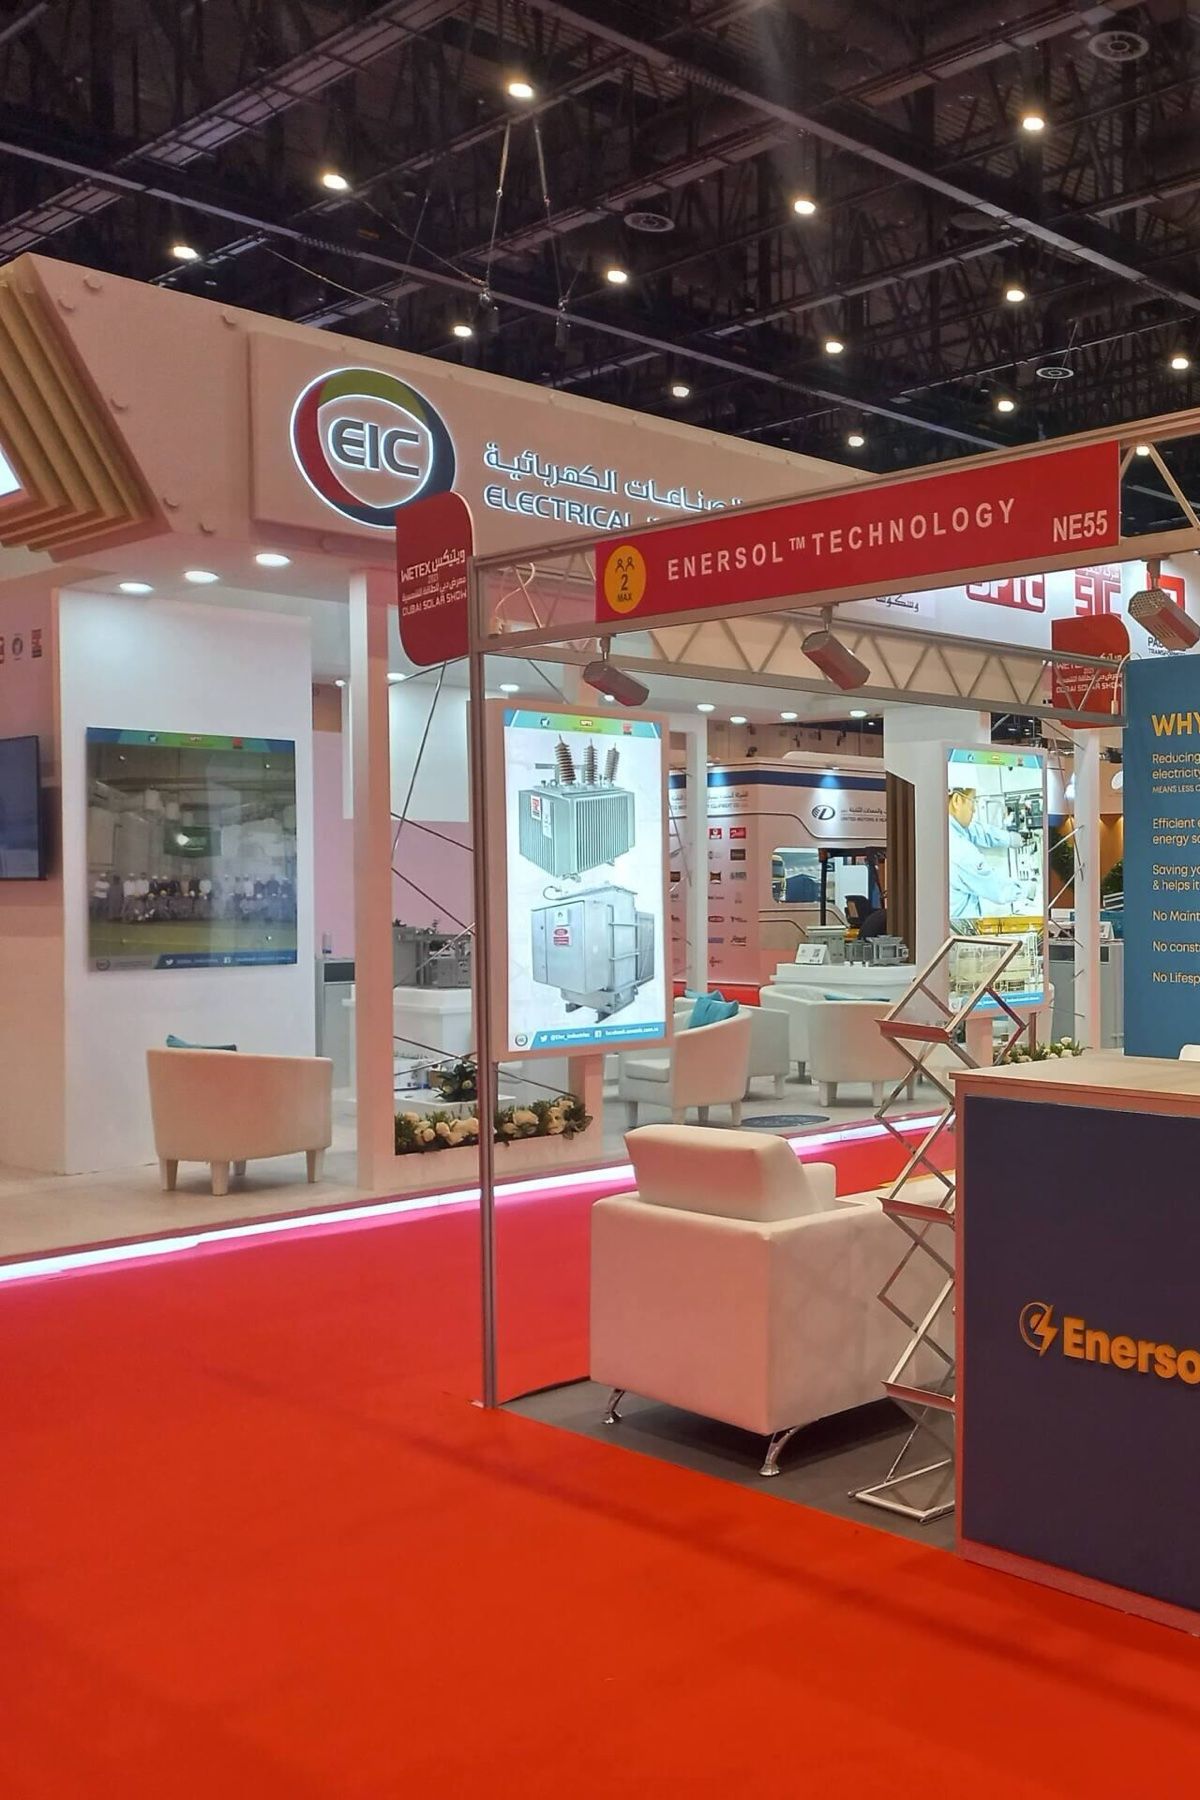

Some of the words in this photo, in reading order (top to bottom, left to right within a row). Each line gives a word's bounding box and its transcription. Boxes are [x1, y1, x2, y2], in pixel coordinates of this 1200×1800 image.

[327, 417, 420, 477] EIC
[483, 440, 616, 494] الكهربائية
[483, 485, 631, 531] ELECTRICAL
[812, 498, 1015, 556] TECHNOLOGY
[1053, 510, 1108, 542] NE55
[401, 561, 431, 583] WETEX
[621, 574, 628, 591] 2
[402, 603, 422, 616] DUBAI
[423, 594, 445, 610] SOLAR
[446, 589, 467, 603] SHOW
[617, 593, 632, 601] MAX
[1152, 752, 1200, 765] Reducing
[1152, 785, 1178, 794] MEANS
[1178, 784, 1195, 793] LESS
[1153, 816, 1195, 829] Efficient
[1152, 834, 1190, 847] energy
[1152, 863, 1188, 877] Saving
[1152, 880, 1160, 891] &
[1162, 879, 1190, 893] helps
[1192, 879, 1200, 891] it
[1152, 910, 1168, 922] No
[1152, 940, 1168, 953] No
[1152, 971, 1168, 984] No
